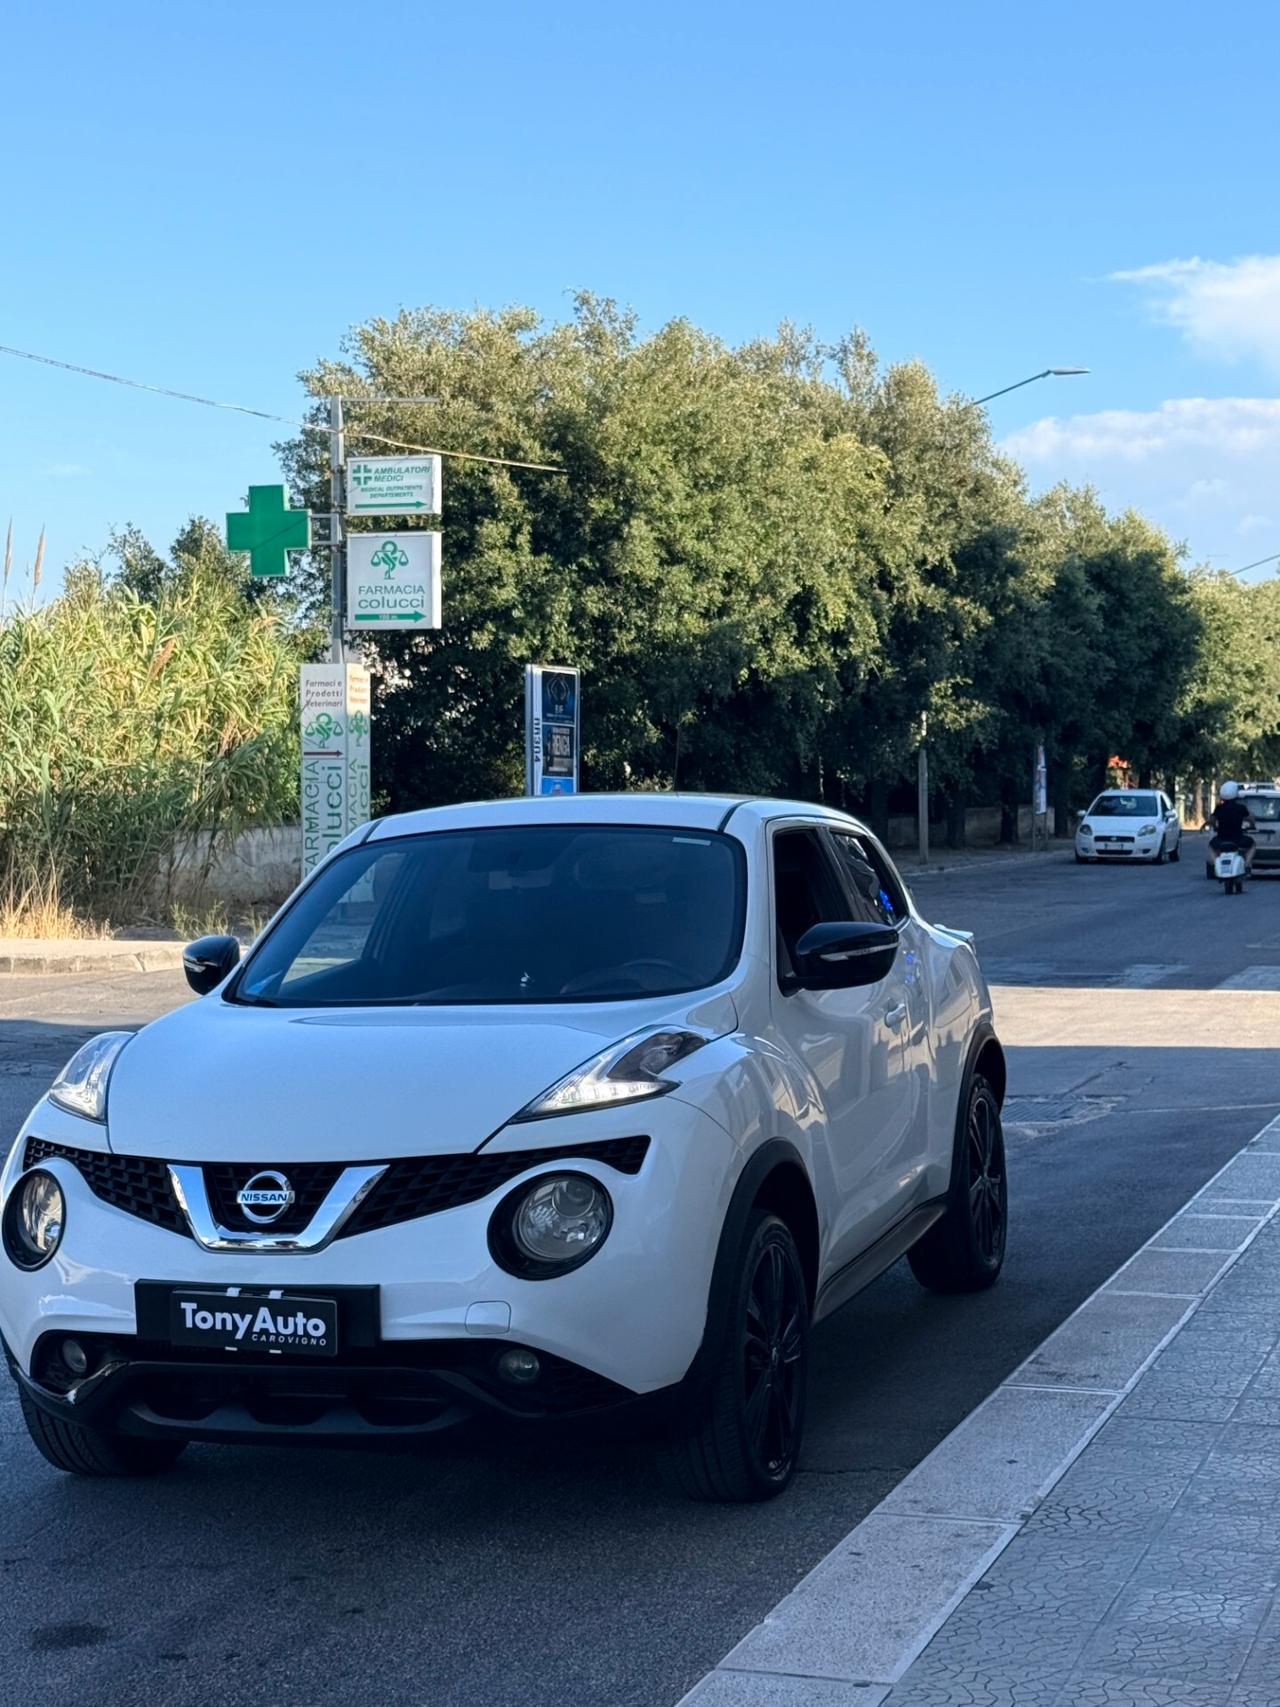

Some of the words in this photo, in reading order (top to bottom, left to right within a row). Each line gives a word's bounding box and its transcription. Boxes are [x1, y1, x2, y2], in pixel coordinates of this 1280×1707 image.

[373, 465, 431, 475] AMBULATORI
[358, 585, 425, 594] FARMACIA
[358, 595, 424, 608] colucci
[241, 1193, 287, 1201] NISSAN
[180, 1302, 326, 1340] TonyAuto
[252, 1333, 326, 1346] CAROVIGNO
